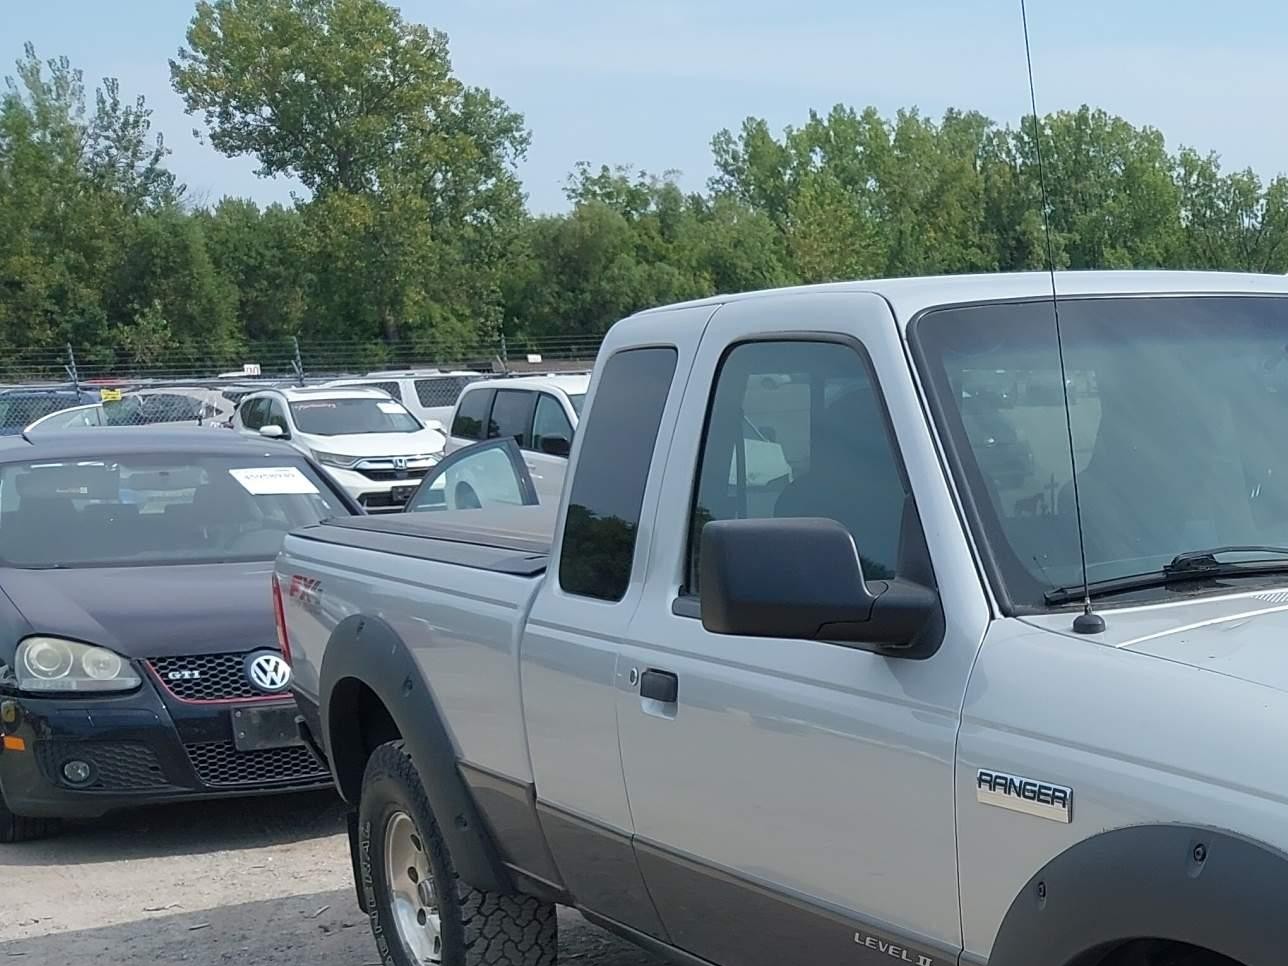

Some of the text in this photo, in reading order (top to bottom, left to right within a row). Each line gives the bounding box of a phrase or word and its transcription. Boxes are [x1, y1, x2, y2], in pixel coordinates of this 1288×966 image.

[168, 670, 201, 680] GTI
[977, 771, 1069, 808] RANGER
[854, 932, 913, 963] LEVEL
